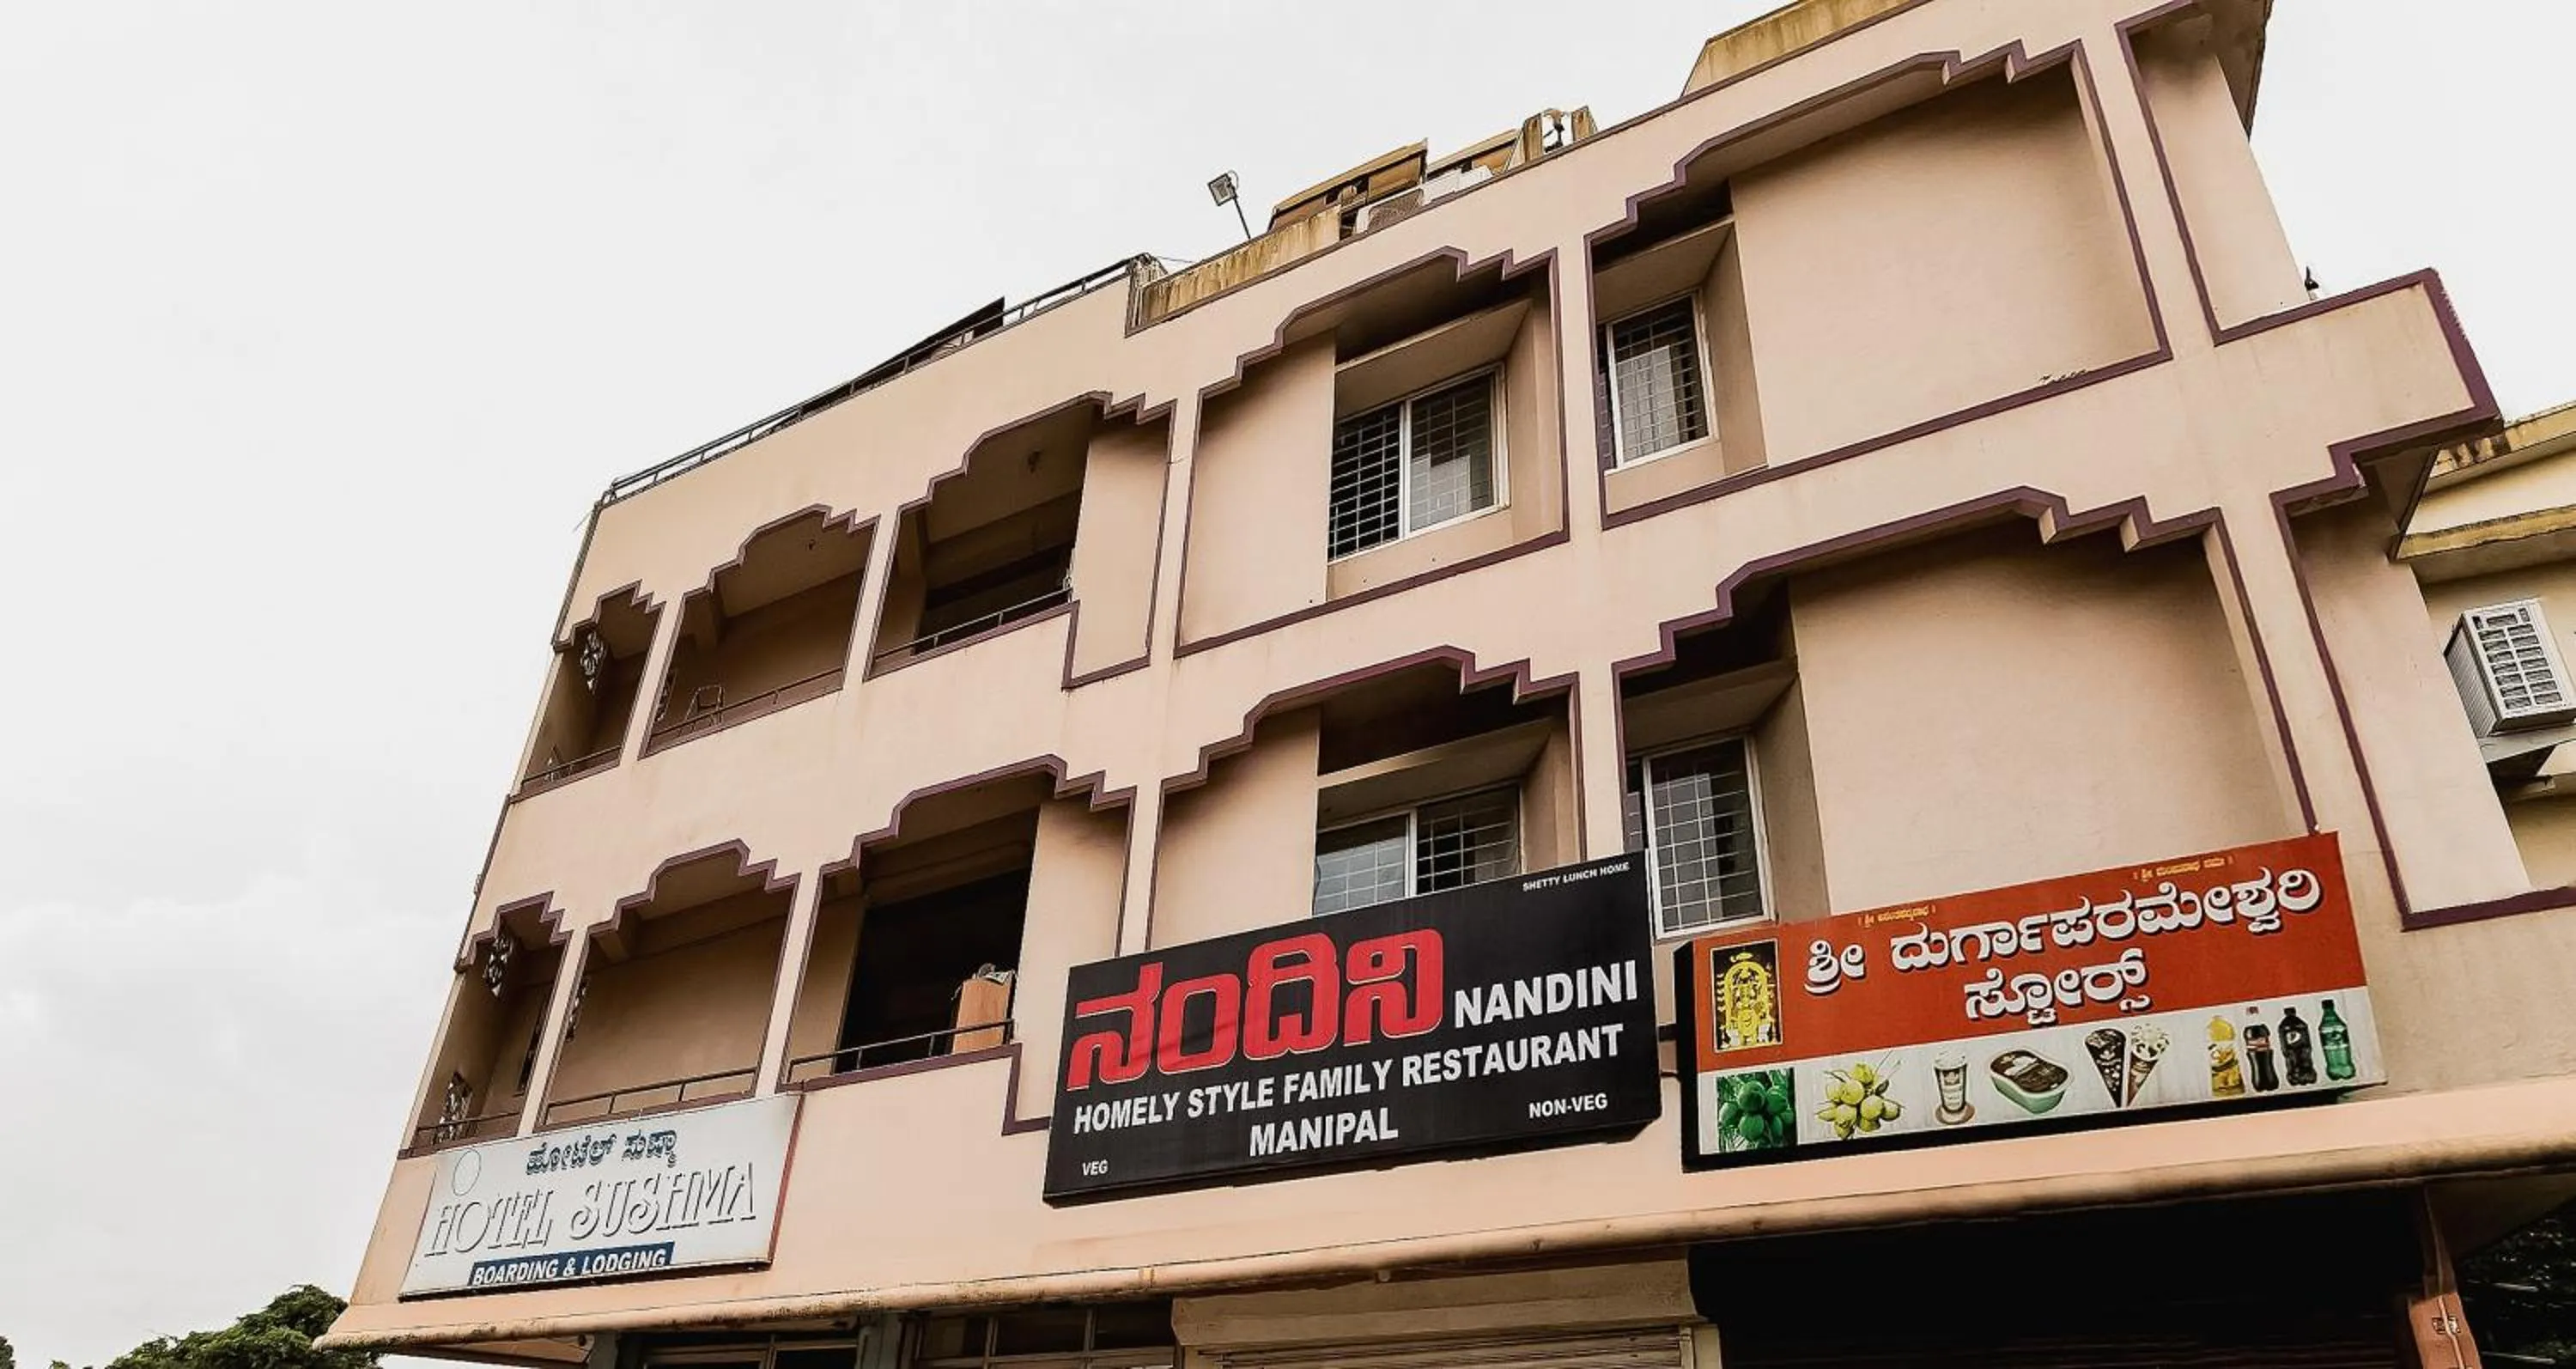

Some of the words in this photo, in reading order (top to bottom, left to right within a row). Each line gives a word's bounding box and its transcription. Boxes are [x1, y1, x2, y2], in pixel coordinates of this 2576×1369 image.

[1522, 874, 1560, 892] SHETTY
[1562, 868, 1598, 885] LUNCH
[1599, 861, 1630, 879] HOME
[1804, 937, 1866, 995] ಶ್ರೀ
[1890, 865, 2324, 971] ದುರ್ಗಾಪರಮೇಶ್ವರಿ
[1066, 928, 1444, 1092] ನಂದಿನಿ
[1454, 959, 1638, 1028] NANDINI
[1073, 1091, 1182, 1135] HOMELY
[1187, 1075, 1273, 1116] STYLE
[1284, 1060, 1393, 1104] FAMILY
[1401, 1023, 1624, 1087] RESTAURANT
[1528, 1092, 1608, 1119] NON-VEG
[526, 1134, 617, 1175] ಹೋಟೆಲ್
[1249, 1107, 1399, 1158] MANIPAL
[1082, 1160, 1109, 1177] VEG
[424, 1189, 553, 1257] HOTEL
[569, 1162, 756, 1239] SUSHMA
[472, 1259, 558, 1286] BOARDING
[562, 1258, 576, 1276] &
[580, 1248, 666, 1275] LODGING
